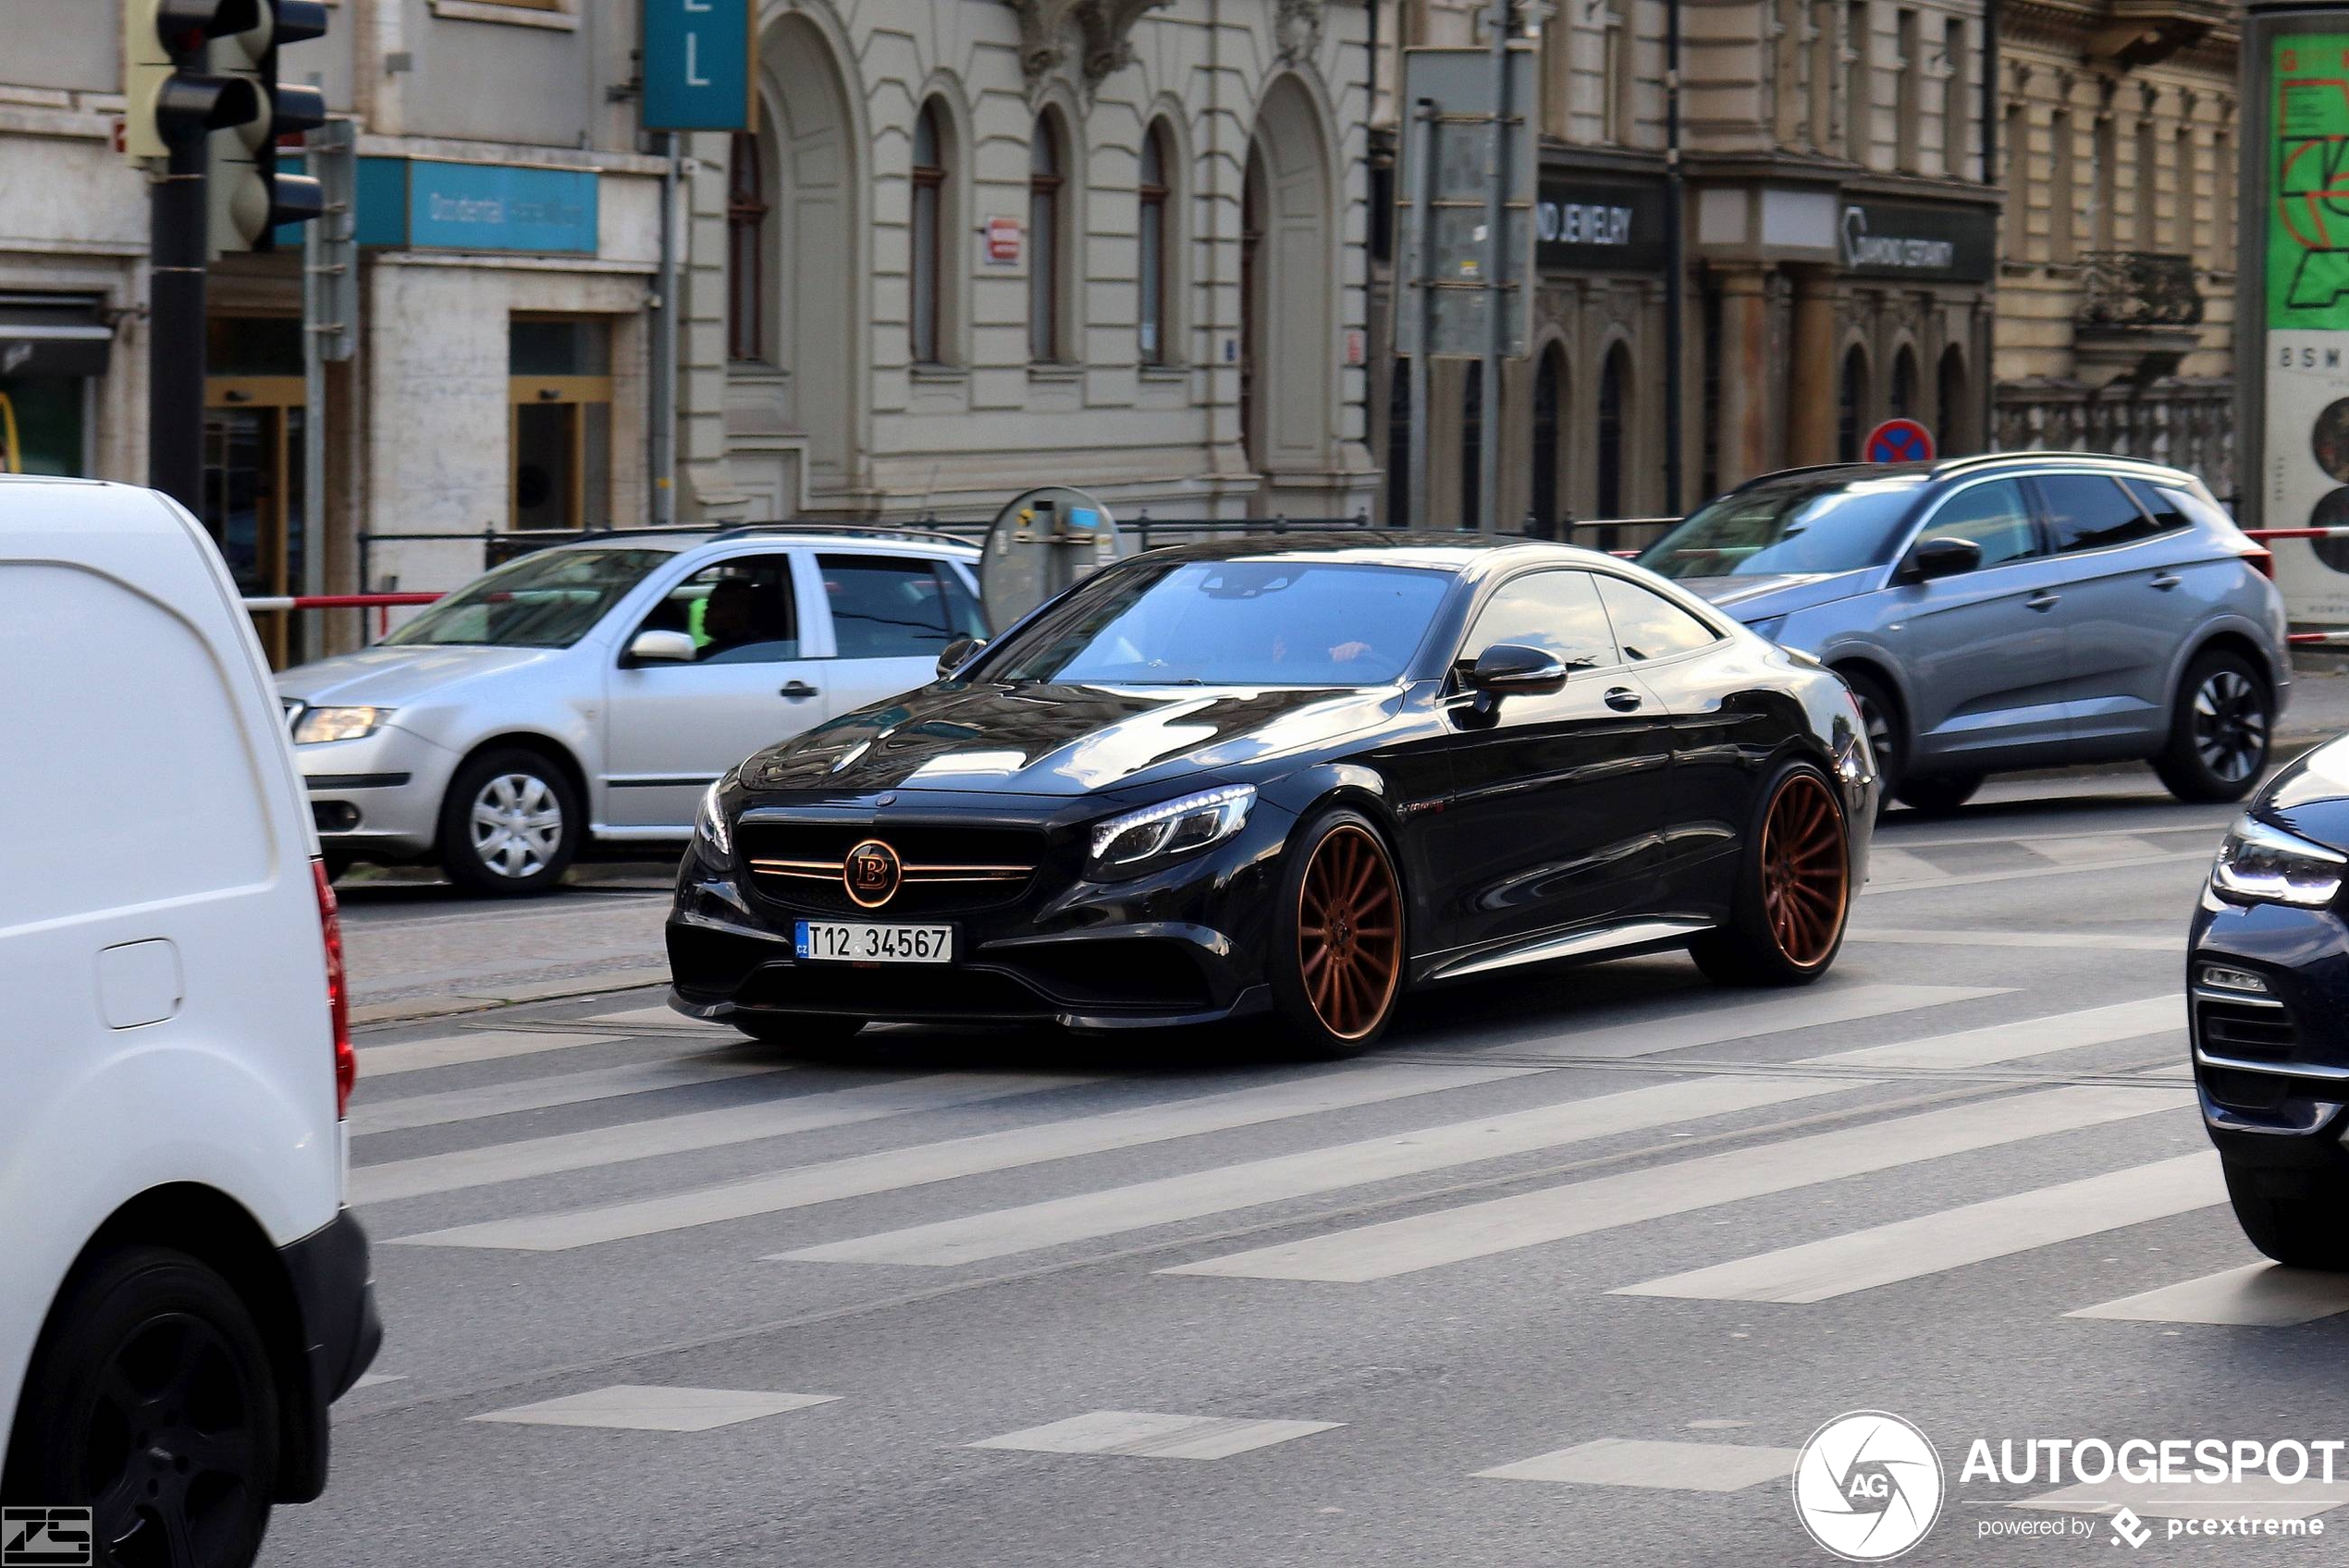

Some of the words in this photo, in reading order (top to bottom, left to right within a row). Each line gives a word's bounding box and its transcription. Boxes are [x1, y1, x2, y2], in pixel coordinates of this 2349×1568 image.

[796, 945, 808, 954] CZ
[809, 926, 850, 956] T12
[866, 928, 946, 959] 34567
